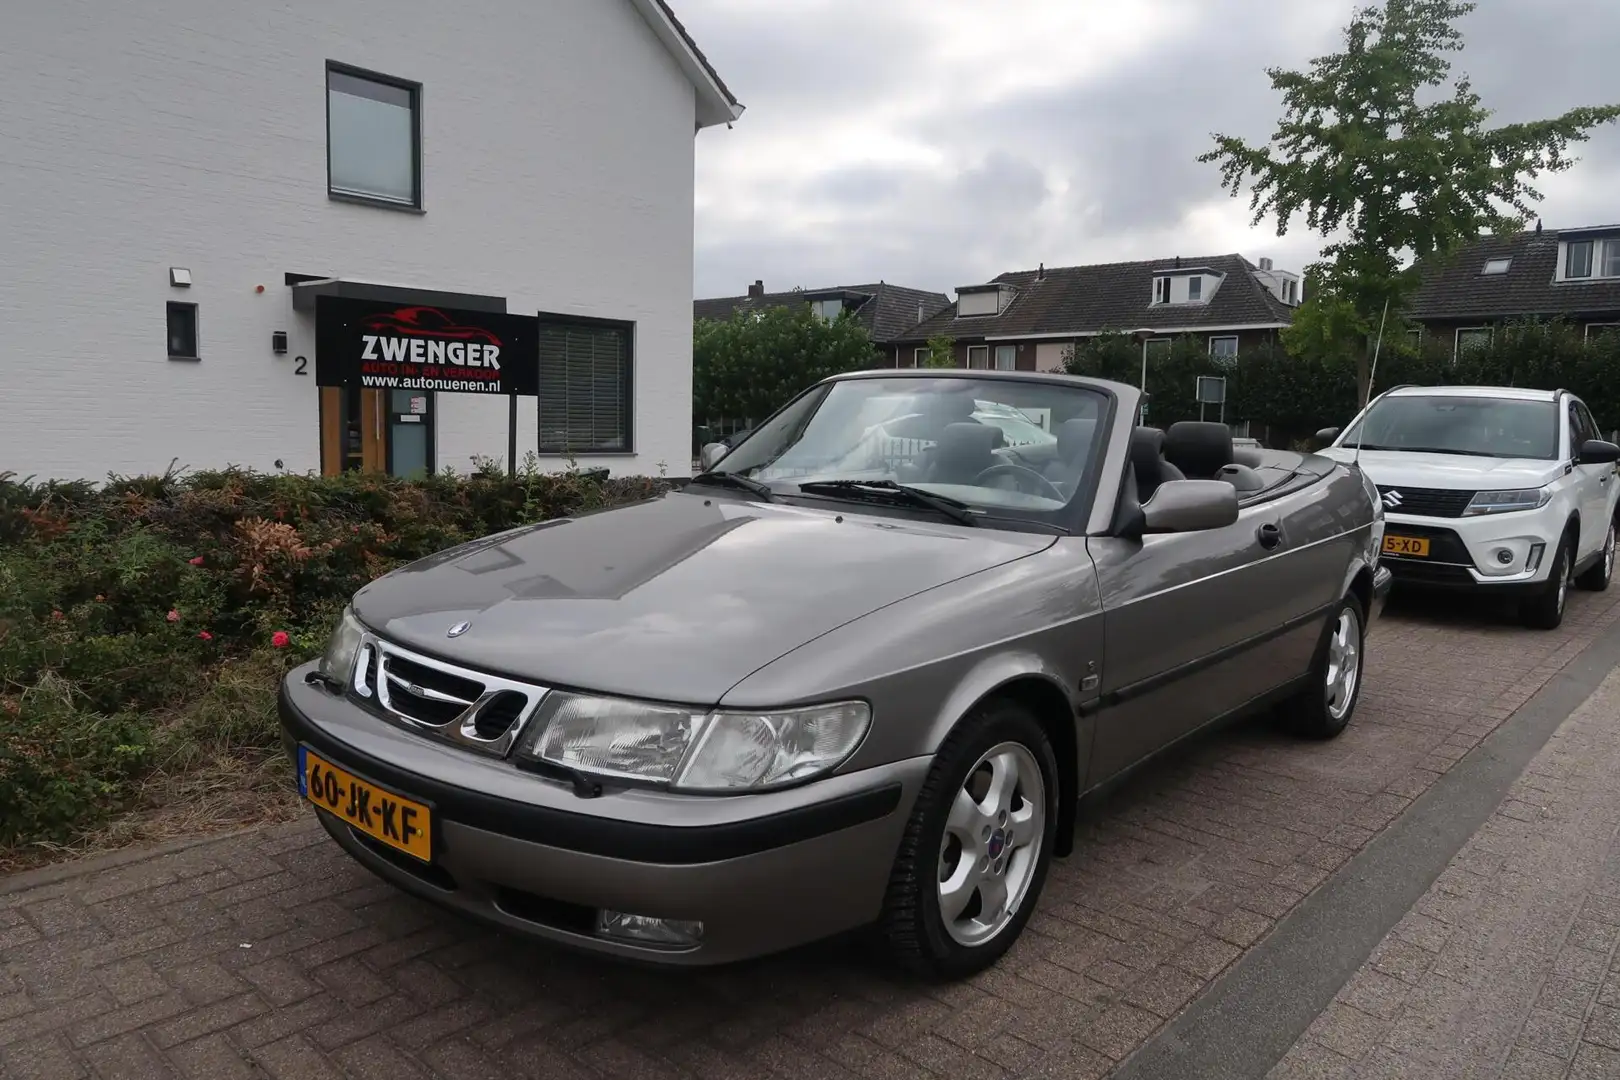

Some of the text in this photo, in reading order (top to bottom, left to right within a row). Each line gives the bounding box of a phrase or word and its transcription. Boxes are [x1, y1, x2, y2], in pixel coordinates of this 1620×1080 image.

[361, 335, 500, 370] ZWENGER
[295, 356, 307, 375] 2
[362, 362, 398, 374] AUTO
[423, 366, 439, 377] EN
[443, 367, 500, 380] VERKOOP
[362, 375, 500, 392] www.autonuenen.nl
[311, 764, 417, 845] 60-JK-KF
